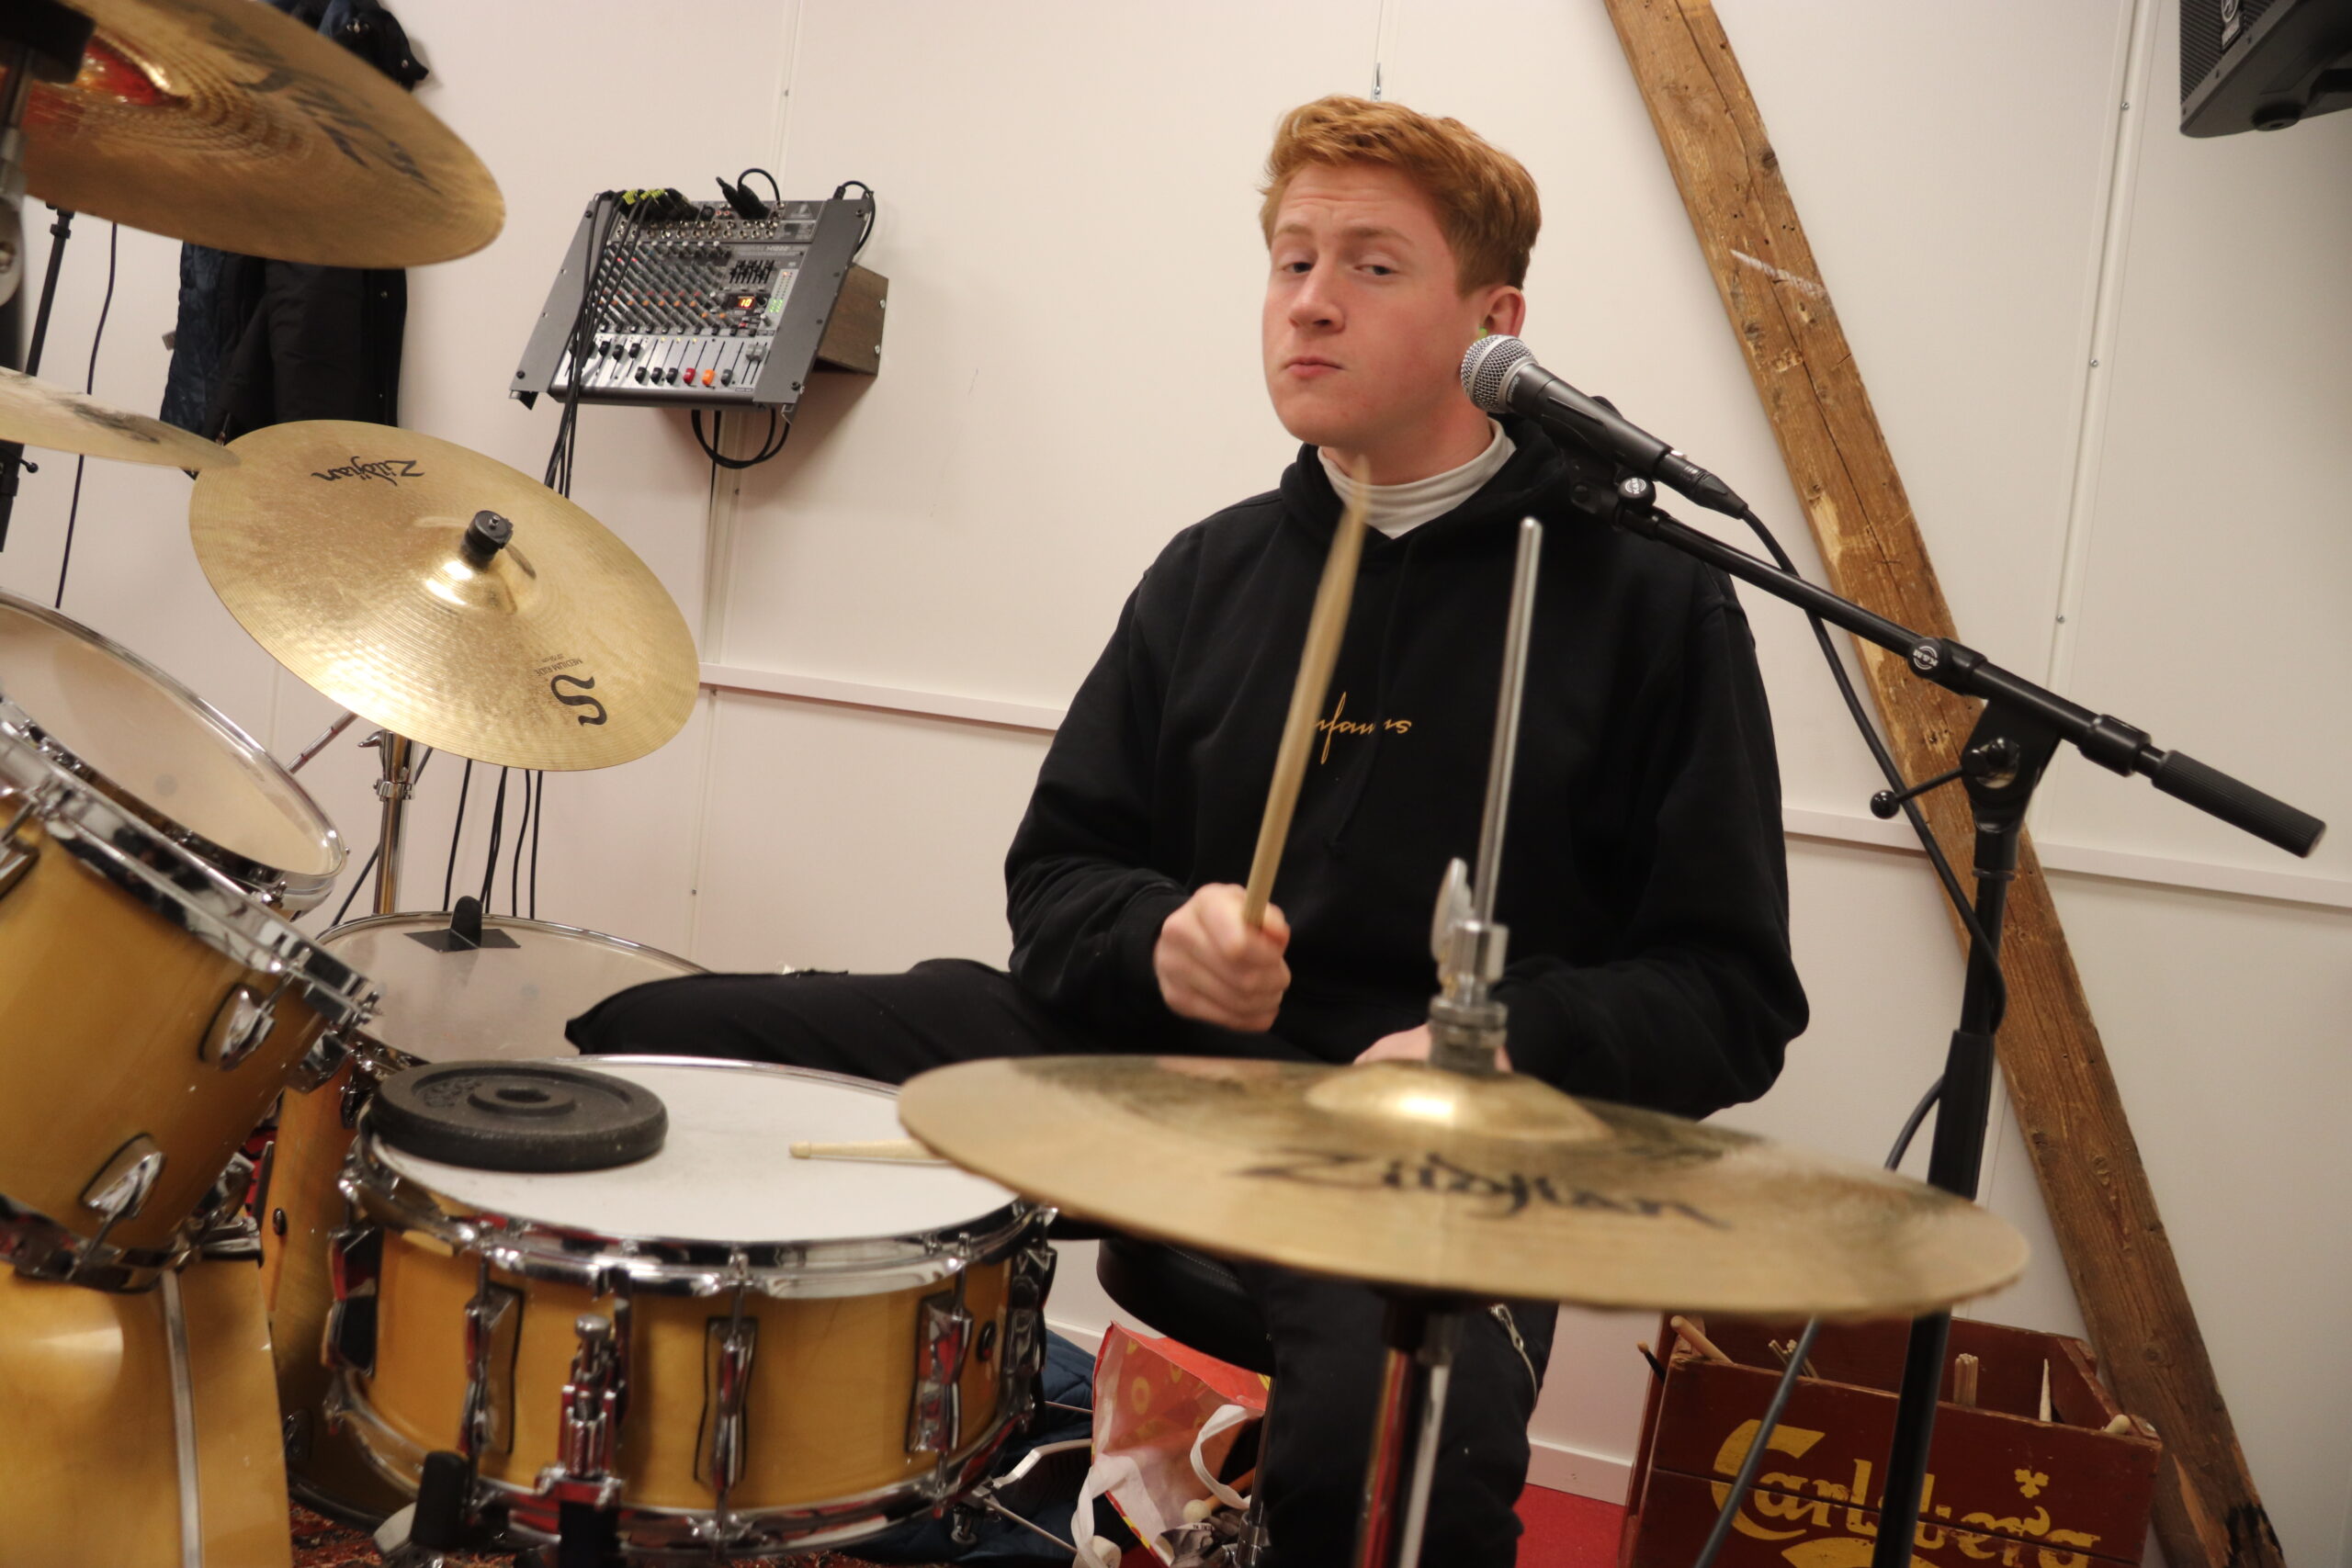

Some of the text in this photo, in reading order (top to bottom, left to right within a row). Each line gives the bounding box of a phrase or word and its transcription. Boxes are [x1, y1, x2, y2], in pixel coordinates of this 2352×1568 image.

[311, 456, 425, 487] Zildjian
[1913, 649, 1938, 666] K&M
[550, 674, 607, 727] S
[1233, 1149, 1729, 1228] Zildjian
[1711, 1418, 2102, 1568] Carlberg
